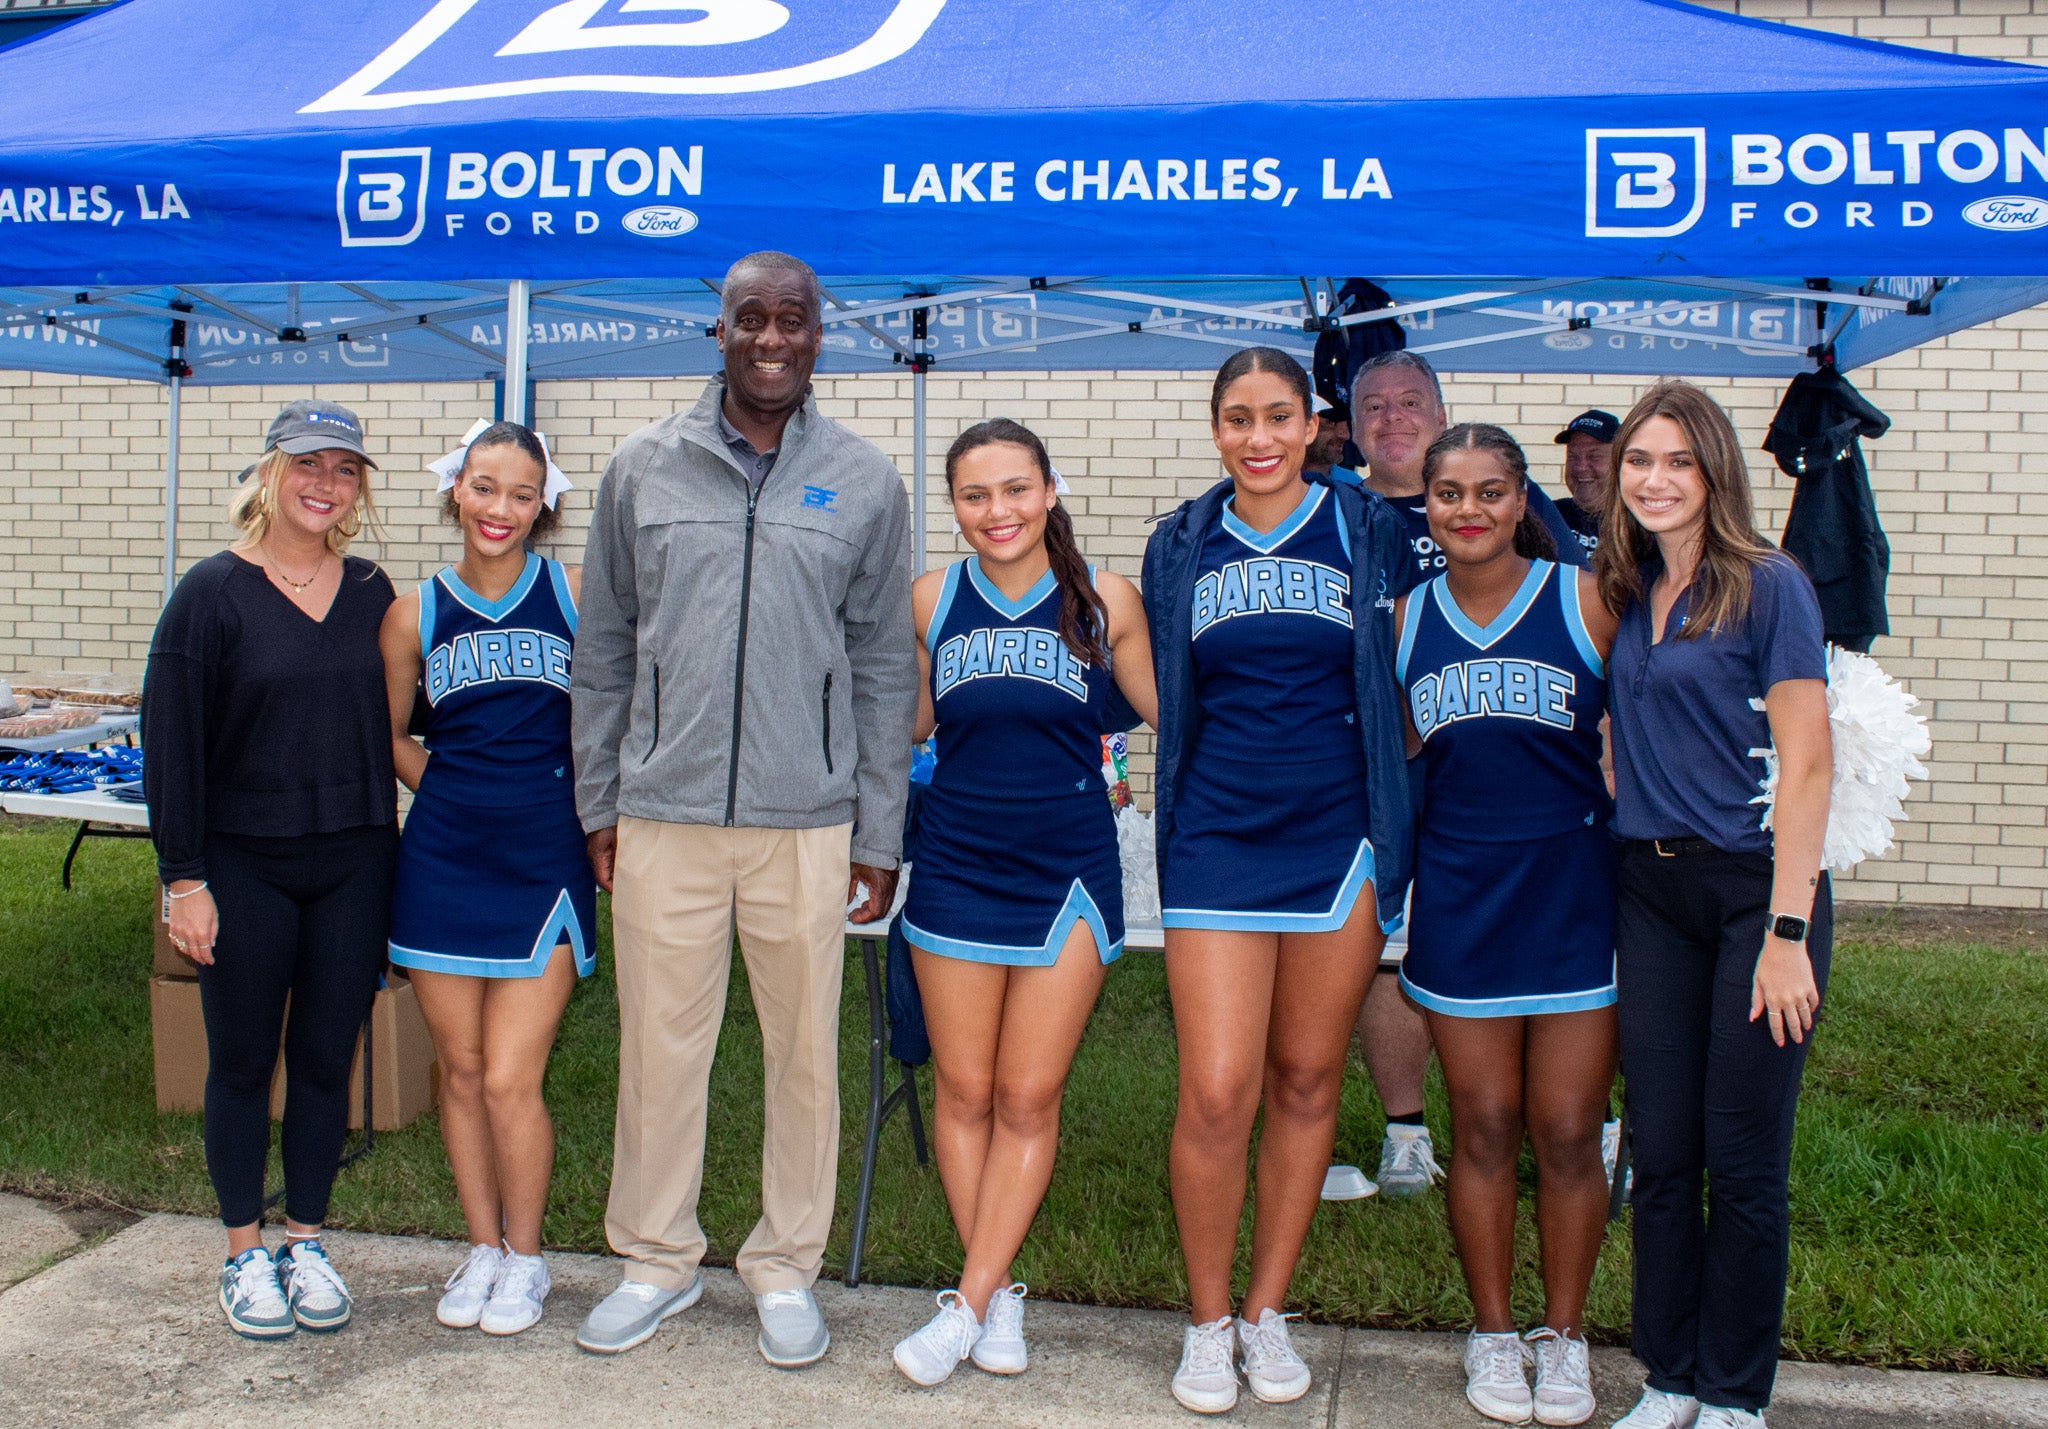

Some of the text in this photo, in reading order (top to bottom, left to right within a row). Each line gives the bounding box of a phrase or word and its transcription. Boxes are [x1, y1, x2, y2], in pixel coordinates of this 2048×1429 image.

[446, 146, 703, 200] BOLTON
[1731, 127, 2048, 185] BOLTON
[136, 184, 191, 220] LA
[883, 158, 1393, 207] LAKE CHARLES, LA
[446, 210, 600, 237] FORD
[636, 207, 684, 232] Ford
[1731, 200, 1934, 228] FORD
[1982, 201, 2040, 224] Ford
[1191, 556, 1354, 641] BARBE
[425, 628, 572, 709] BARBE
[936, 626, 1091, 703] BARBE
[1410, 658, 1576, 743] BARBE
